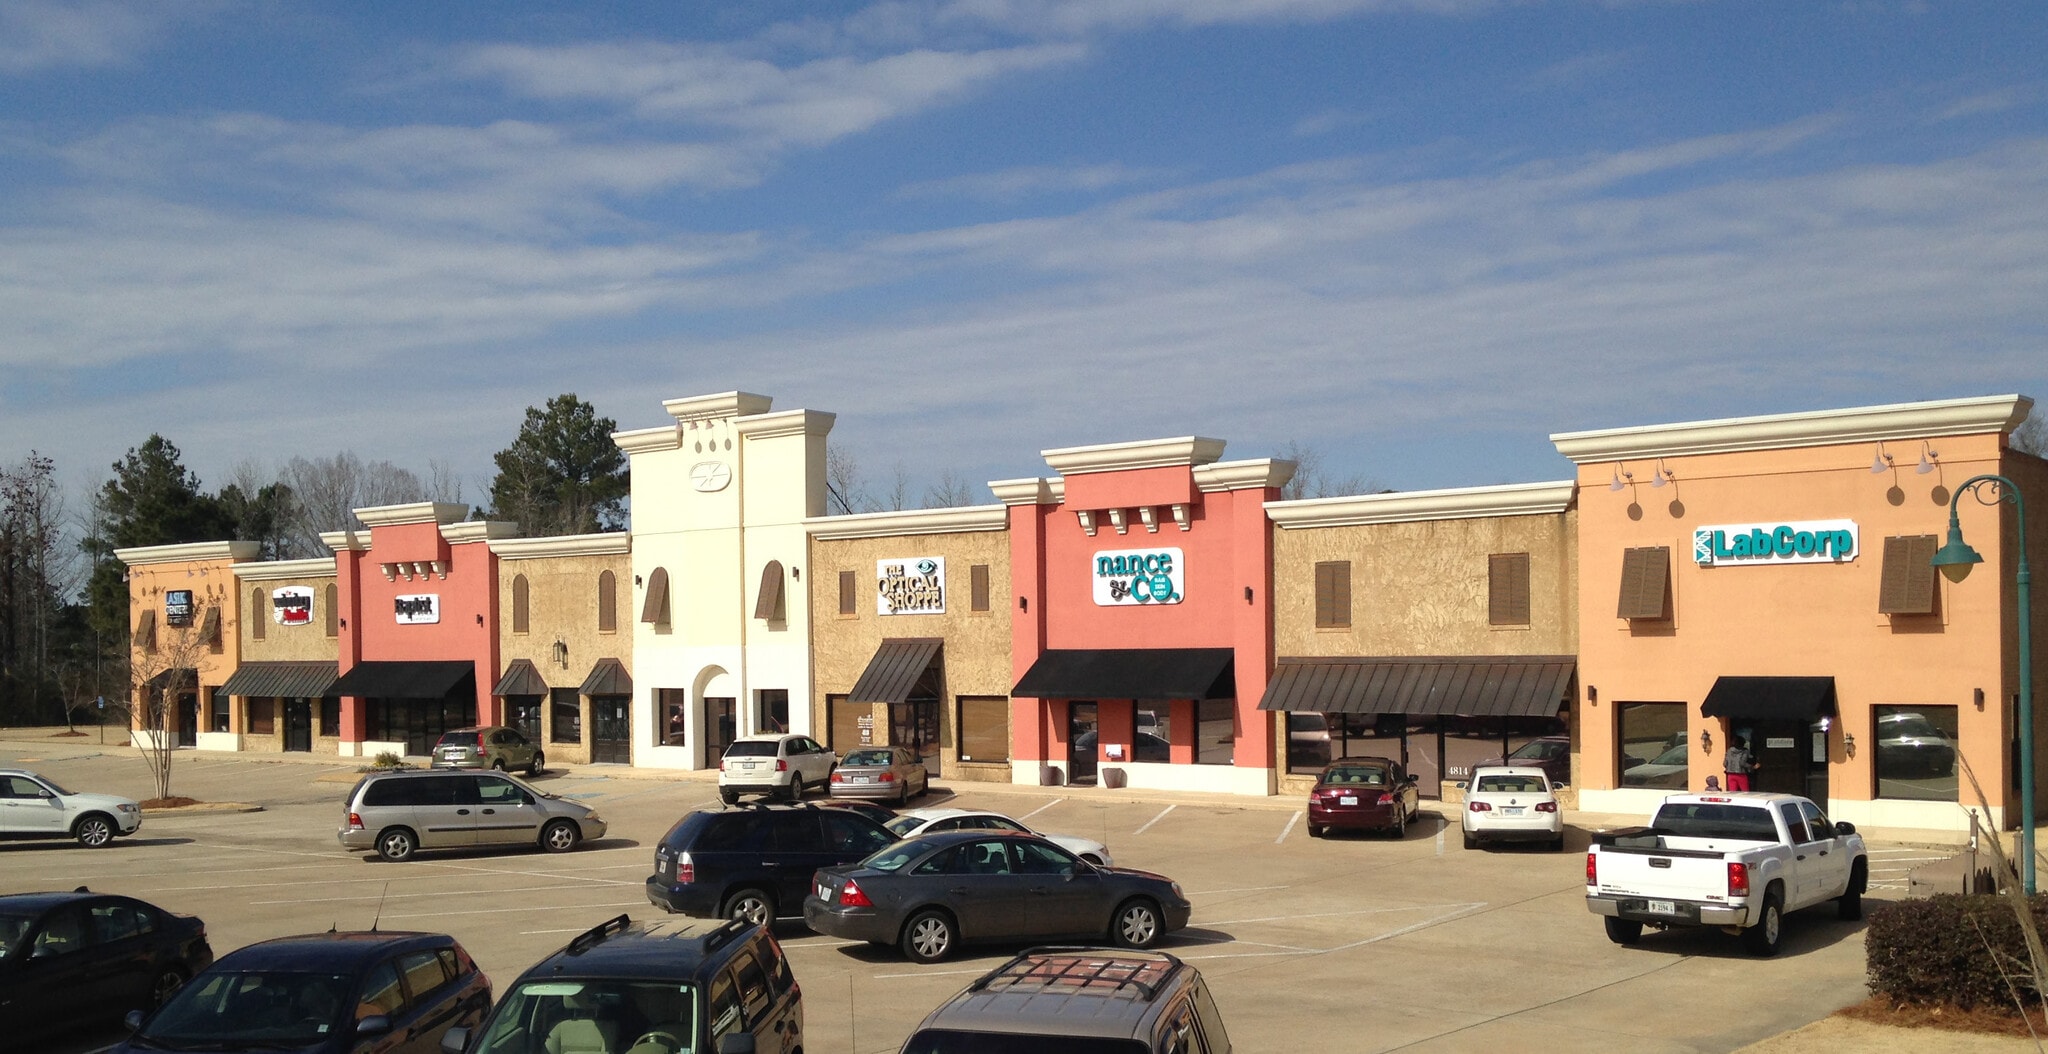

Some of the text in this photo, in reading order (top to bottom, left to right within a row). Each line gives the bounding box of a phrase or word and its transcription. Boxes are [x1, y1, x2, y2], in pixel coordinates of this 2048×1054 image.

[1714, 525, 1853, 560] LabCorp
[885, 564, 903, 577] THE
[1097, 553, 1172, 576] nance
[878, 577, 940, 597] OPTICAL
[394, 597, 433, 621] Baptist
[887, 591, 941, 612] SHOPPE
[1448, 766, 1468, 776] 4814
